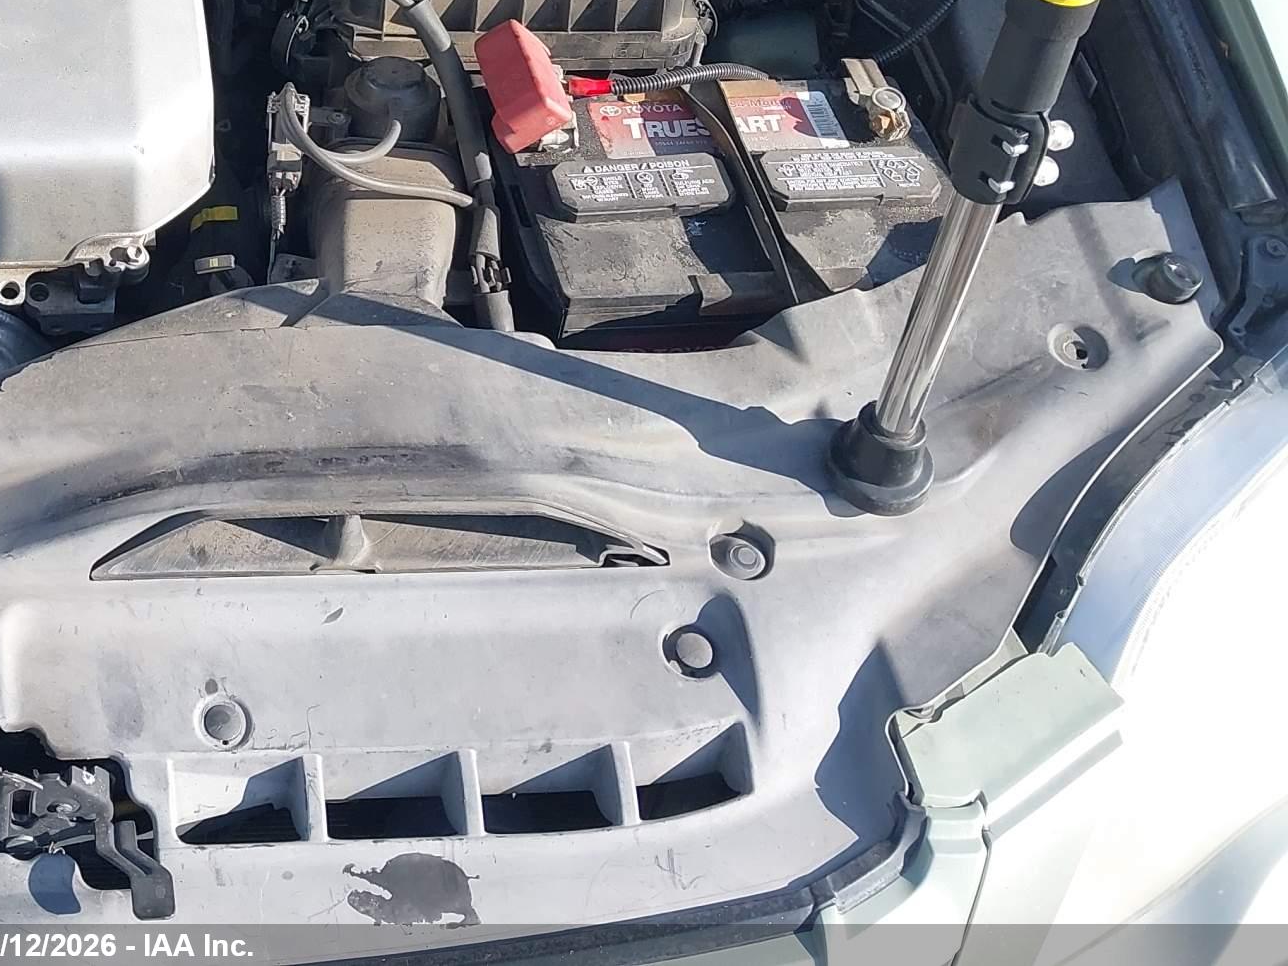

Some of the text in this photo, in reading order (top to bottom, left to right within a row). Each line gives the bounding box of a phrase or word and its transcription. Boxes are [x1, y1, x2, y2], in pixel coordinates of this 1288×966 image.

[623, 102, 683, 114] TOYOTA
[622, 115, 782, 139] TRUESART
[594, 163, 640, 173] DANGER
[649, 159, 690, 170] POISON
